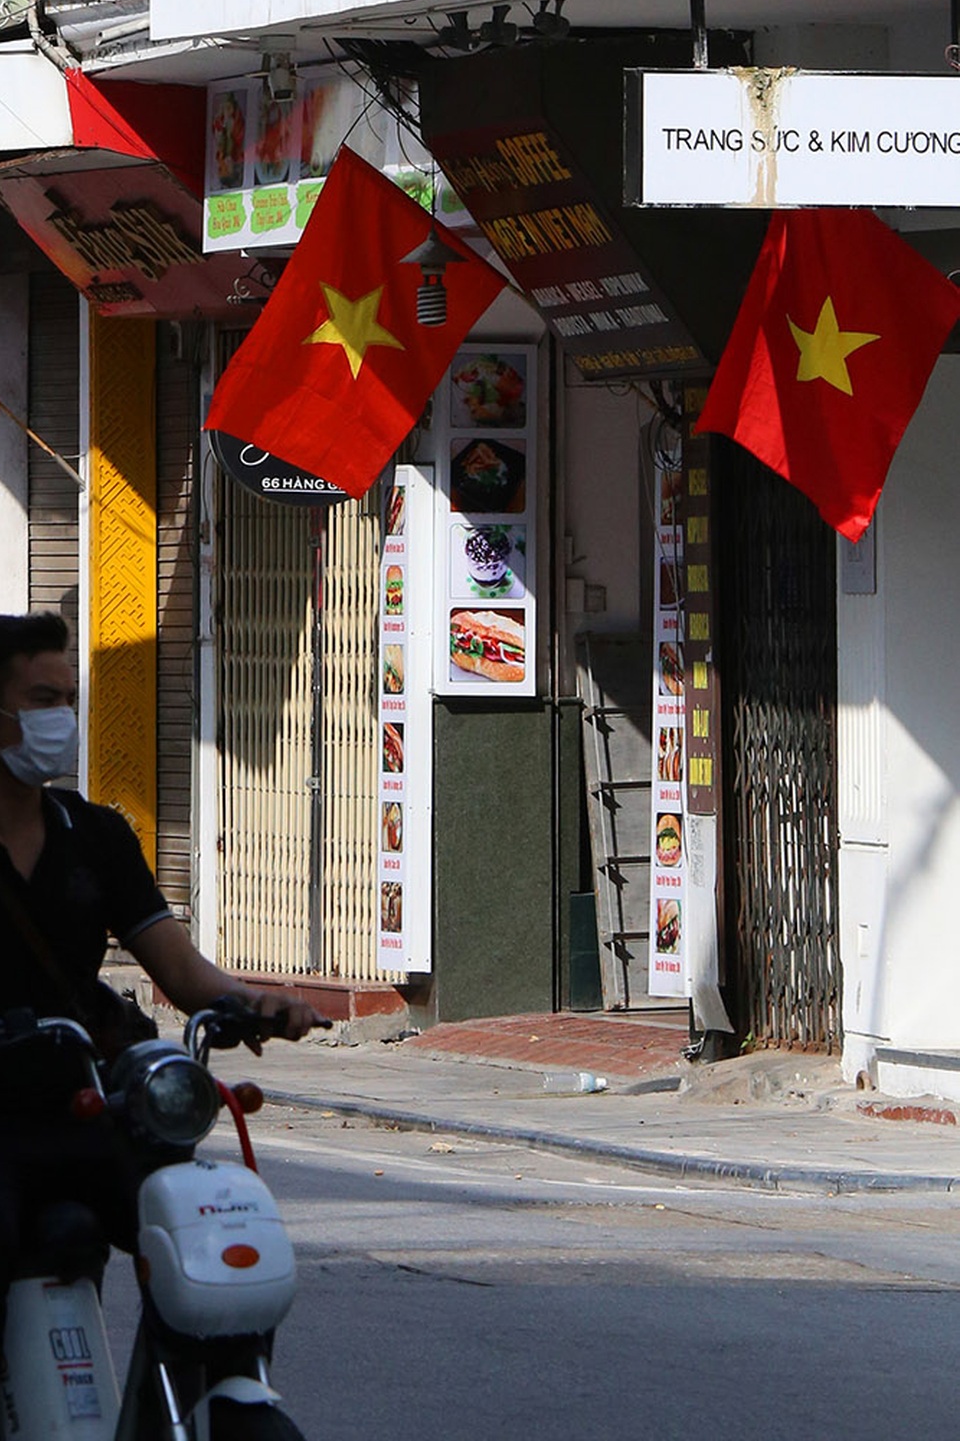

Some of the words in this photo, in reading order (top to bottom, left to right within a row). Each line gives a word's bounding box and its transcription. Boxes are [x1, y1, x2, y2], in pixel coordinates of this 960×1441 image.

[495, 130, 573, 187] COFFEE
[662, 128, 744, 152] TRANG
[808, 130, 824, 153] &
[831, 131, 870, 153] KIM
[480, 216, 538, 262] MADE
[517, 211, 555, 255] IN
[261, 477, 280, 489] 66
[282, 475, 325, 490] HÀNG
